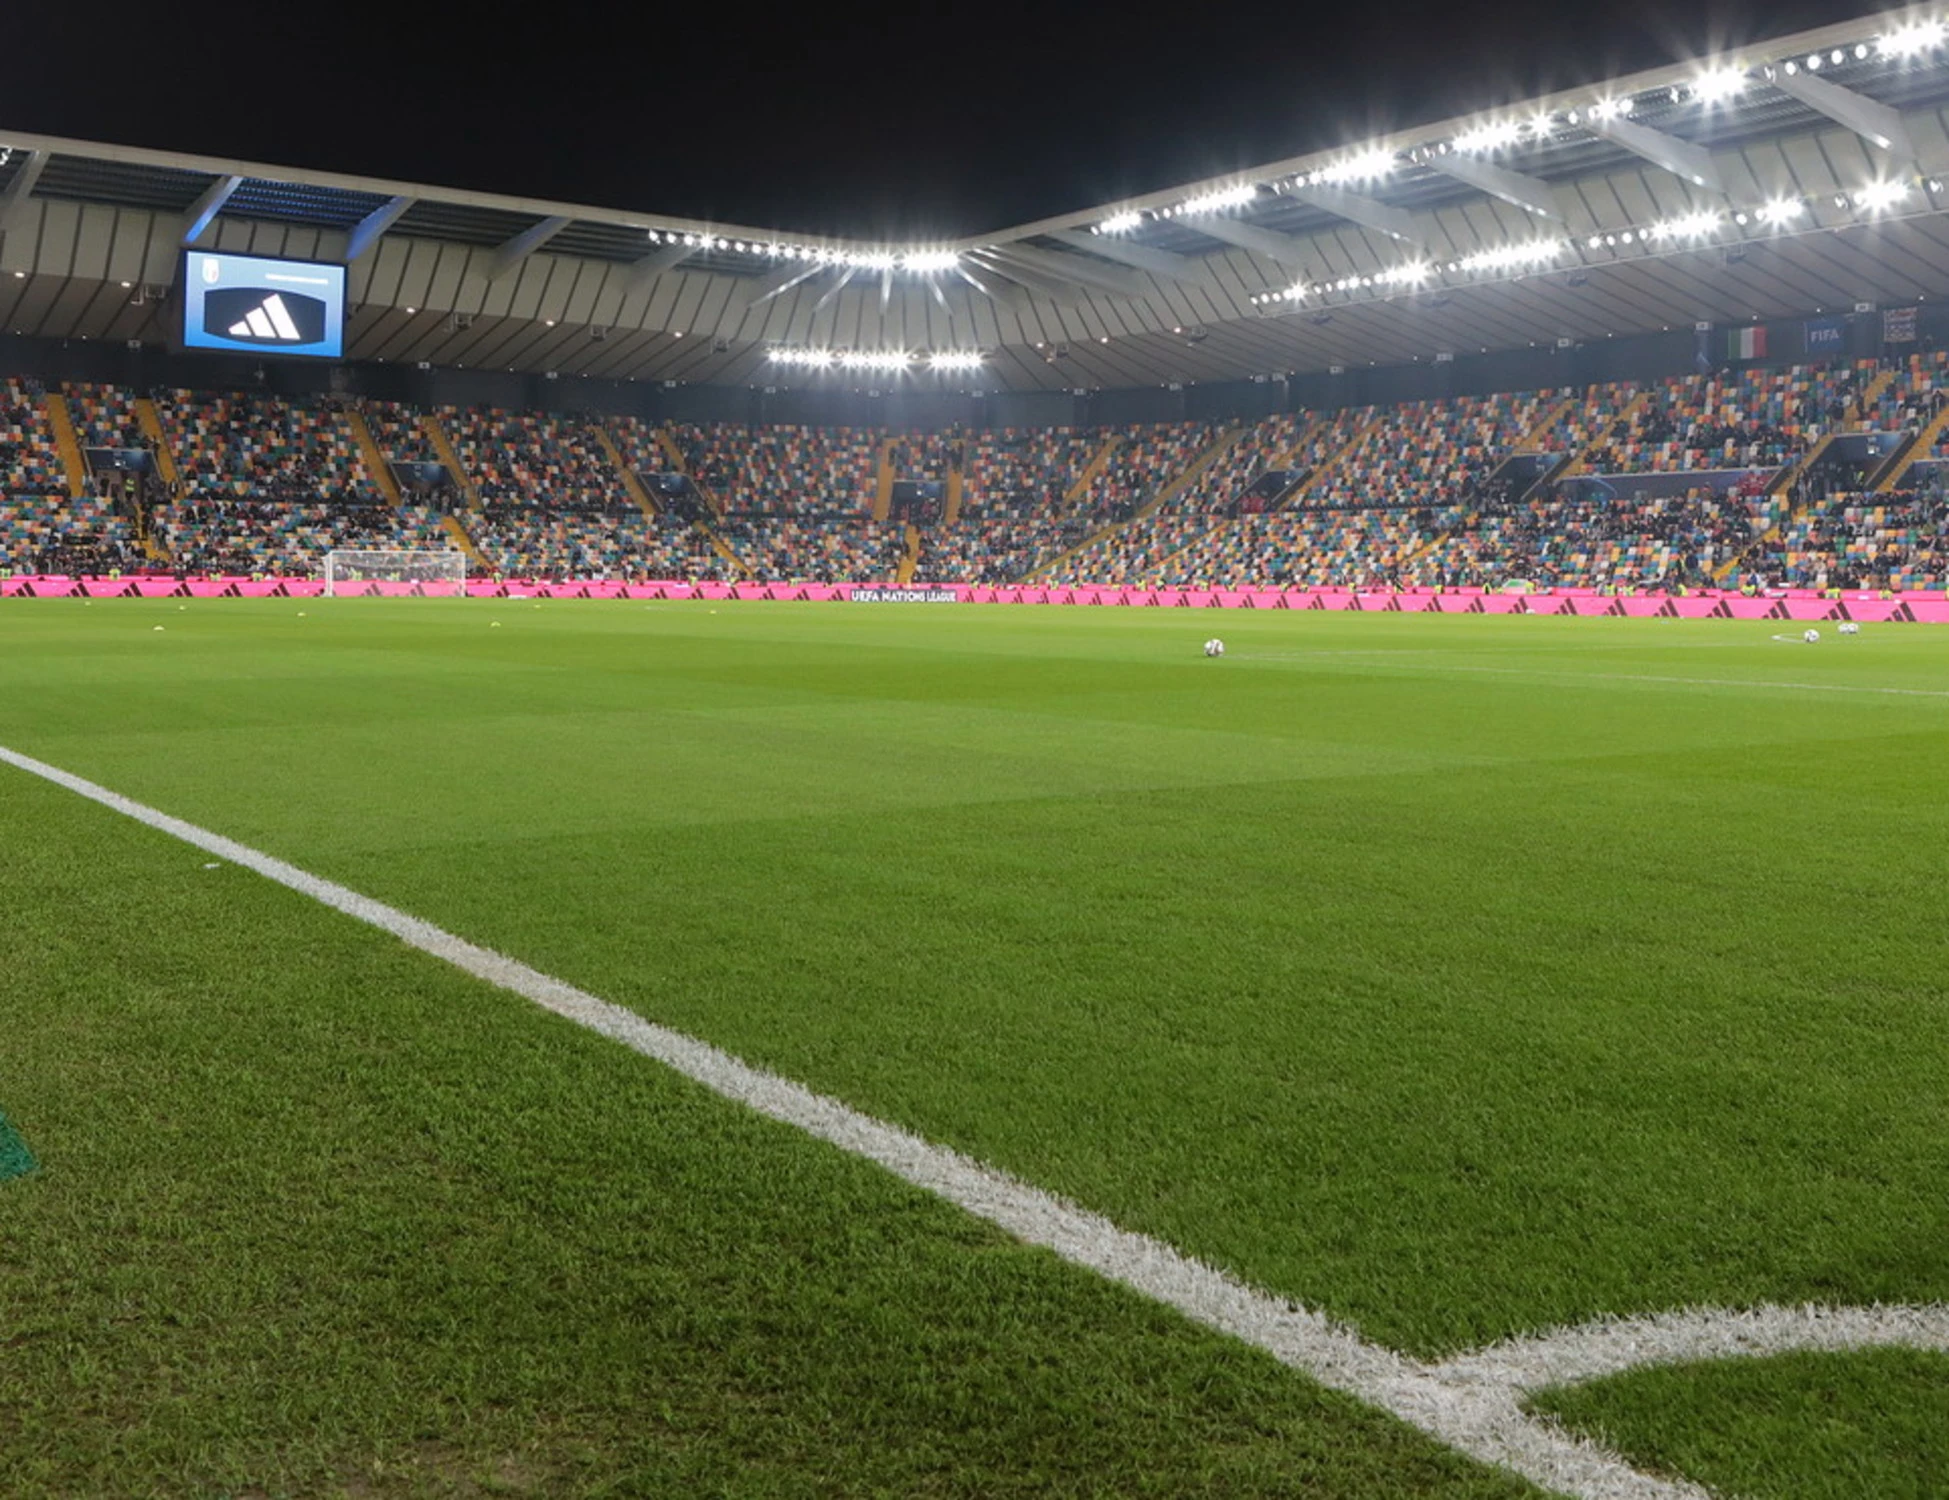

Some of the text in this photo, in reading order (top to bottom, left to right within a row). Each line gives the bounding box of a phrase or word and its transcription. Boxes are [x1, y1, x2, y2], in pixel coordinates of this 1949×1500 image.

[1811, 328, 1840, 342] FIFA
[851, 590, 956, 602] UEFA NATIONS LEAGUE
